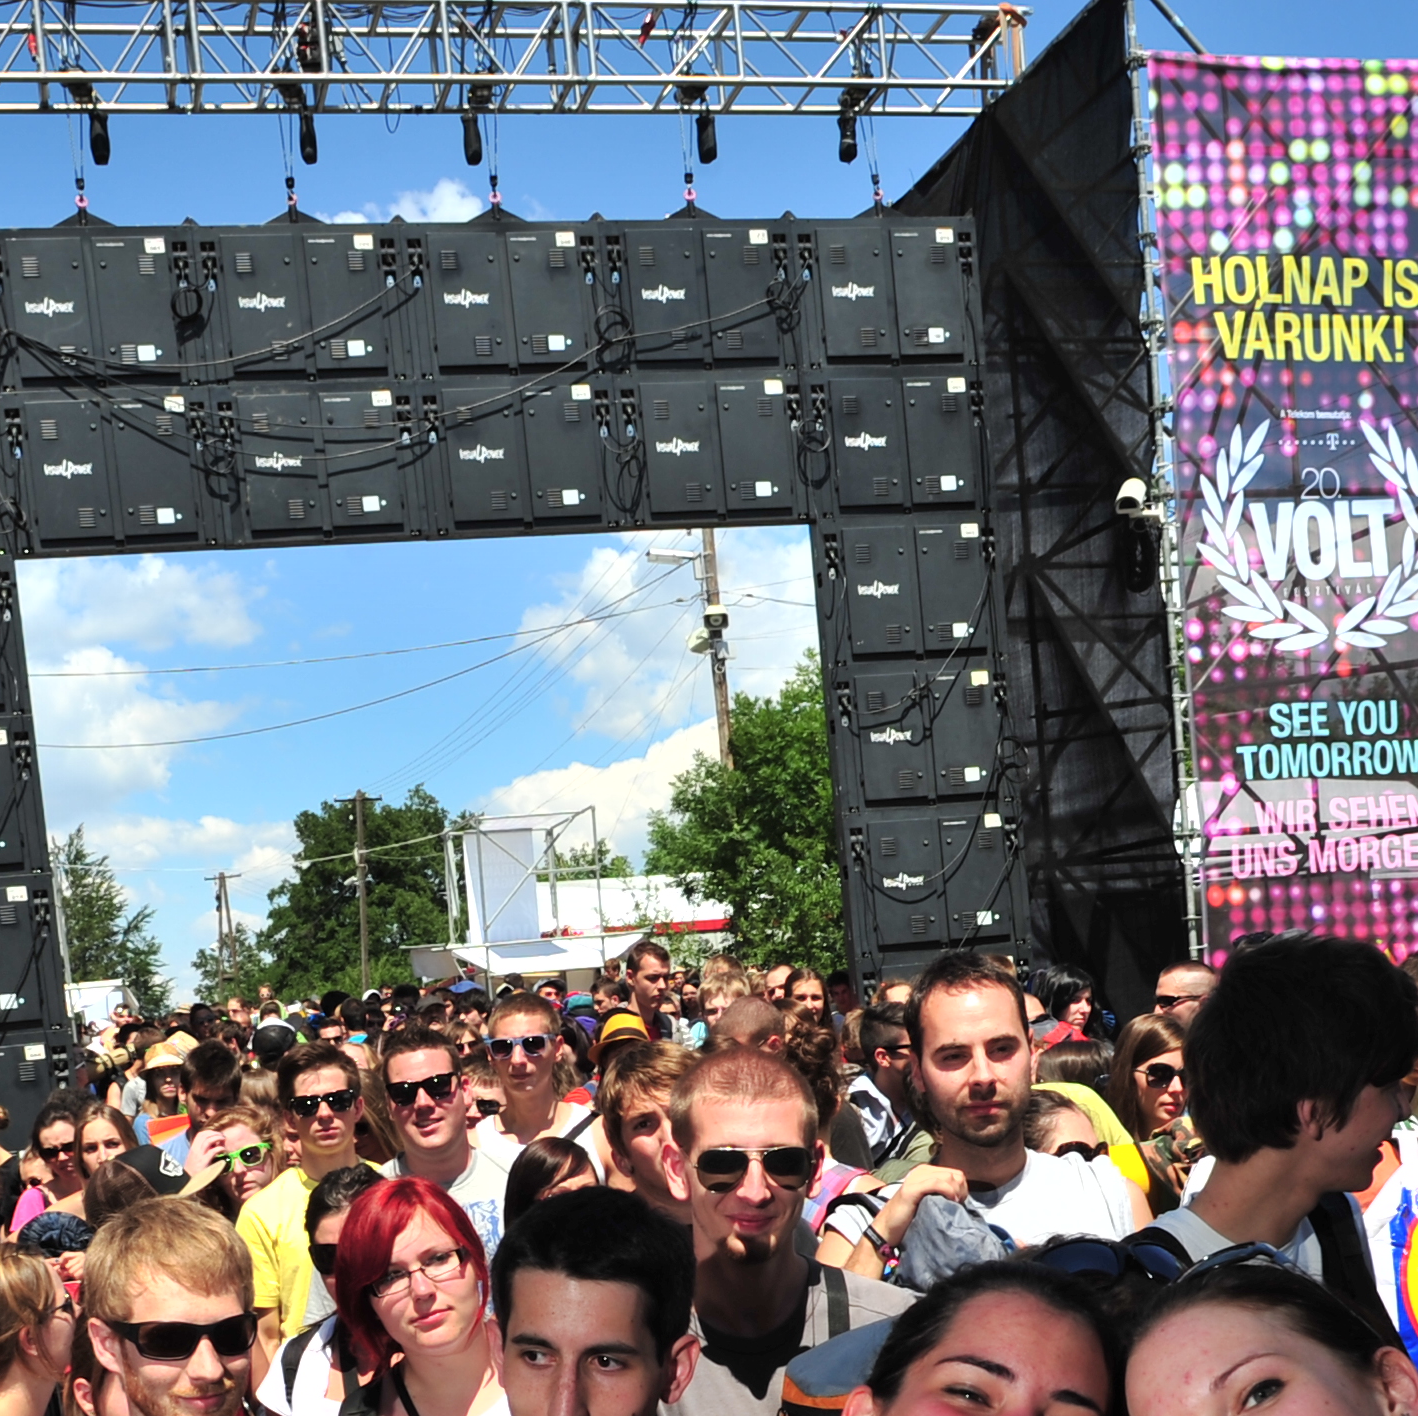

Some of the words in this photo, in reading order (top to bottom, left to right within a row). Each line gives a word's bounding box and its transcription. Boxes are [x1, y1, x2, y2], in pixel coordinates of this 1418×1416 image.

[1191, 255, 1369, 307] HOLNAP
[1214, 301, 1405, 363] VÁRUNK!
[1301, 467, 1342, 500] 20.
[1248, 499, 1395, 581] VOLT
[1269, 701, 1329, 738] SEE
[1339, 699, 1399, 736] YOU
[1255, 797, 1317, 835] WIR
[1231, 841, 1297, 880] UNS
